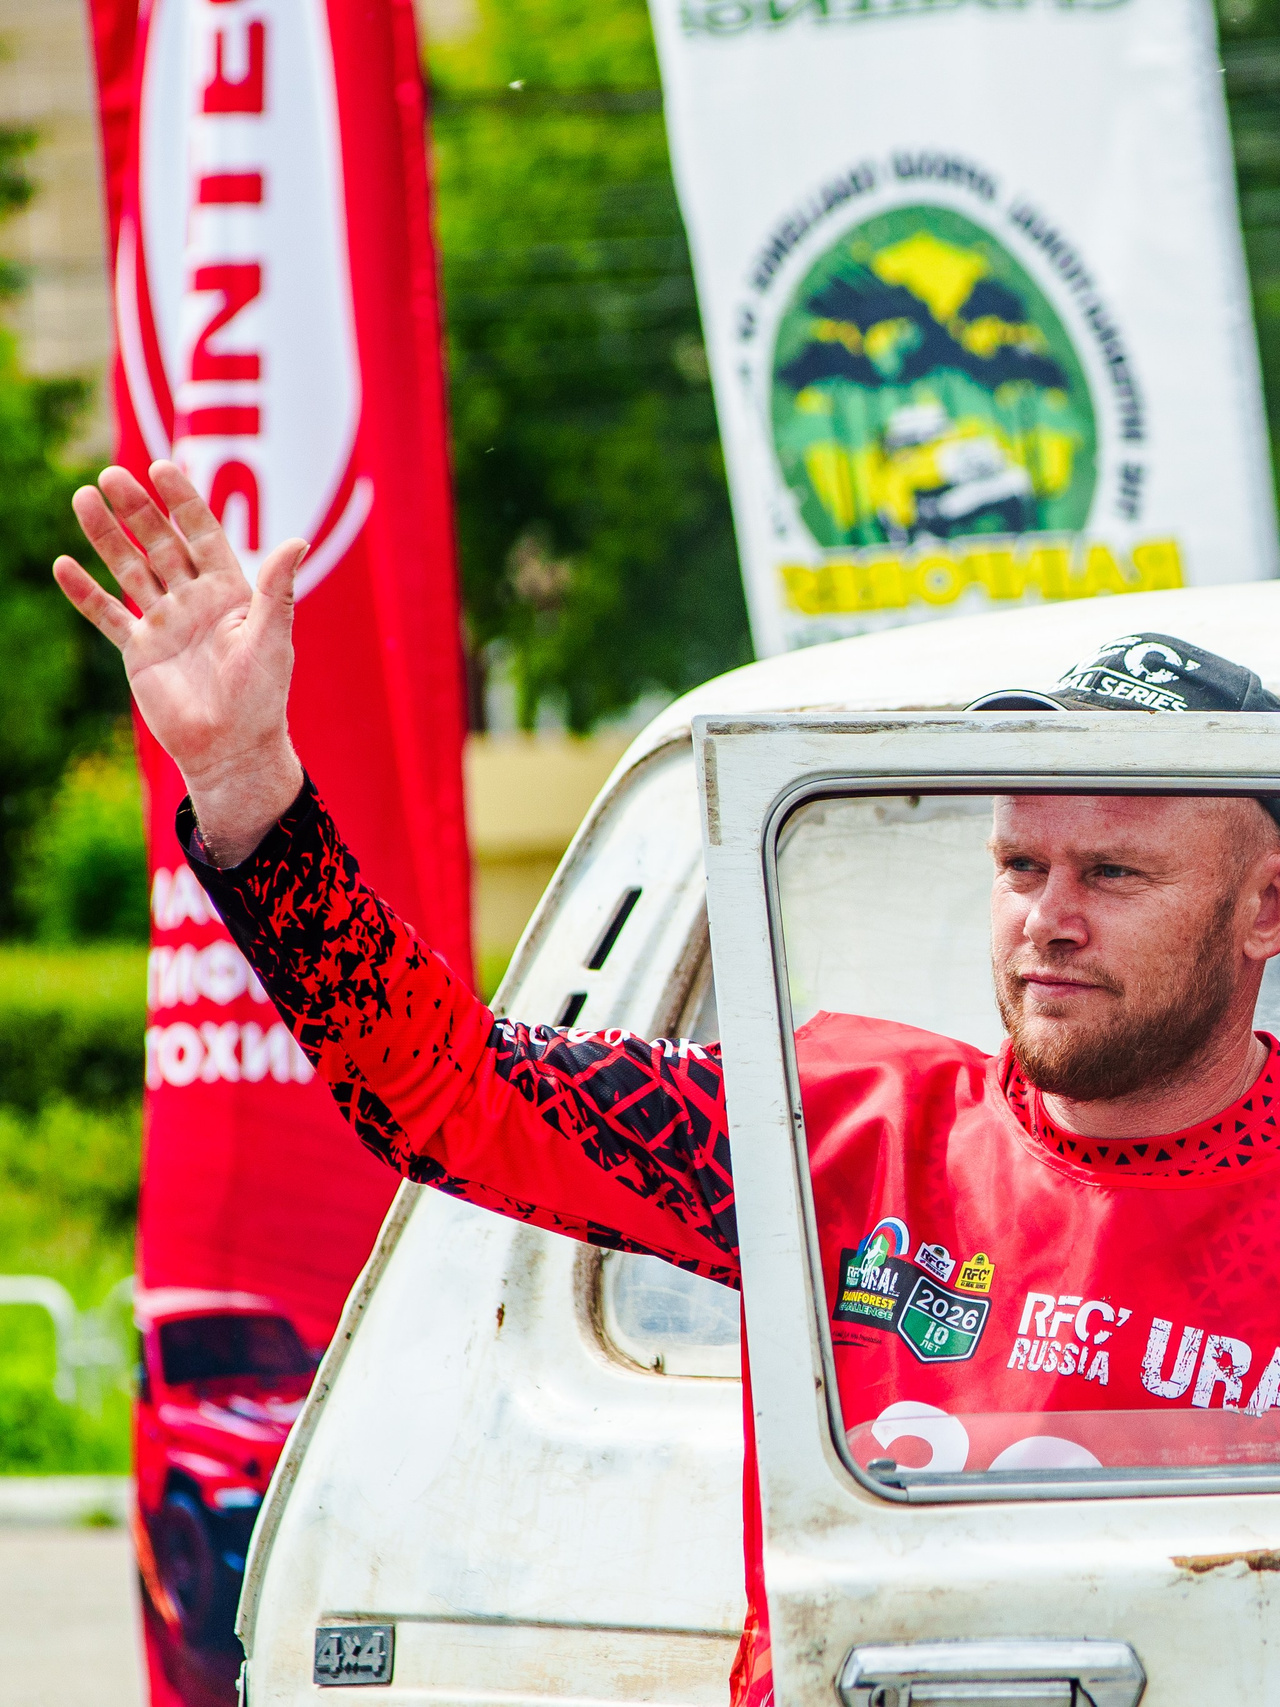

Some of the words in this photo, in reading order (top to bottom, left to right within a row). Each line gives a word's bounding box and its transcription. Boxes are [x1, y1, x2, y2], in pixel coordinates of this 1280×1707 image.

[175, 0, 265, 553] SINTE
[1097, 676, 1189, 711] SERIES
[860, 1262, 900, 1297] URAL
[842, 1289, 896, 1310] RAINFOREST
[915, 1289, 979, 1330] 2026
[920, 1339, 941, 1353] ЛЕТ
[924, 1320, 949, 1346] 10
[1006, 1338, 1110, 1386] RUSSIA
